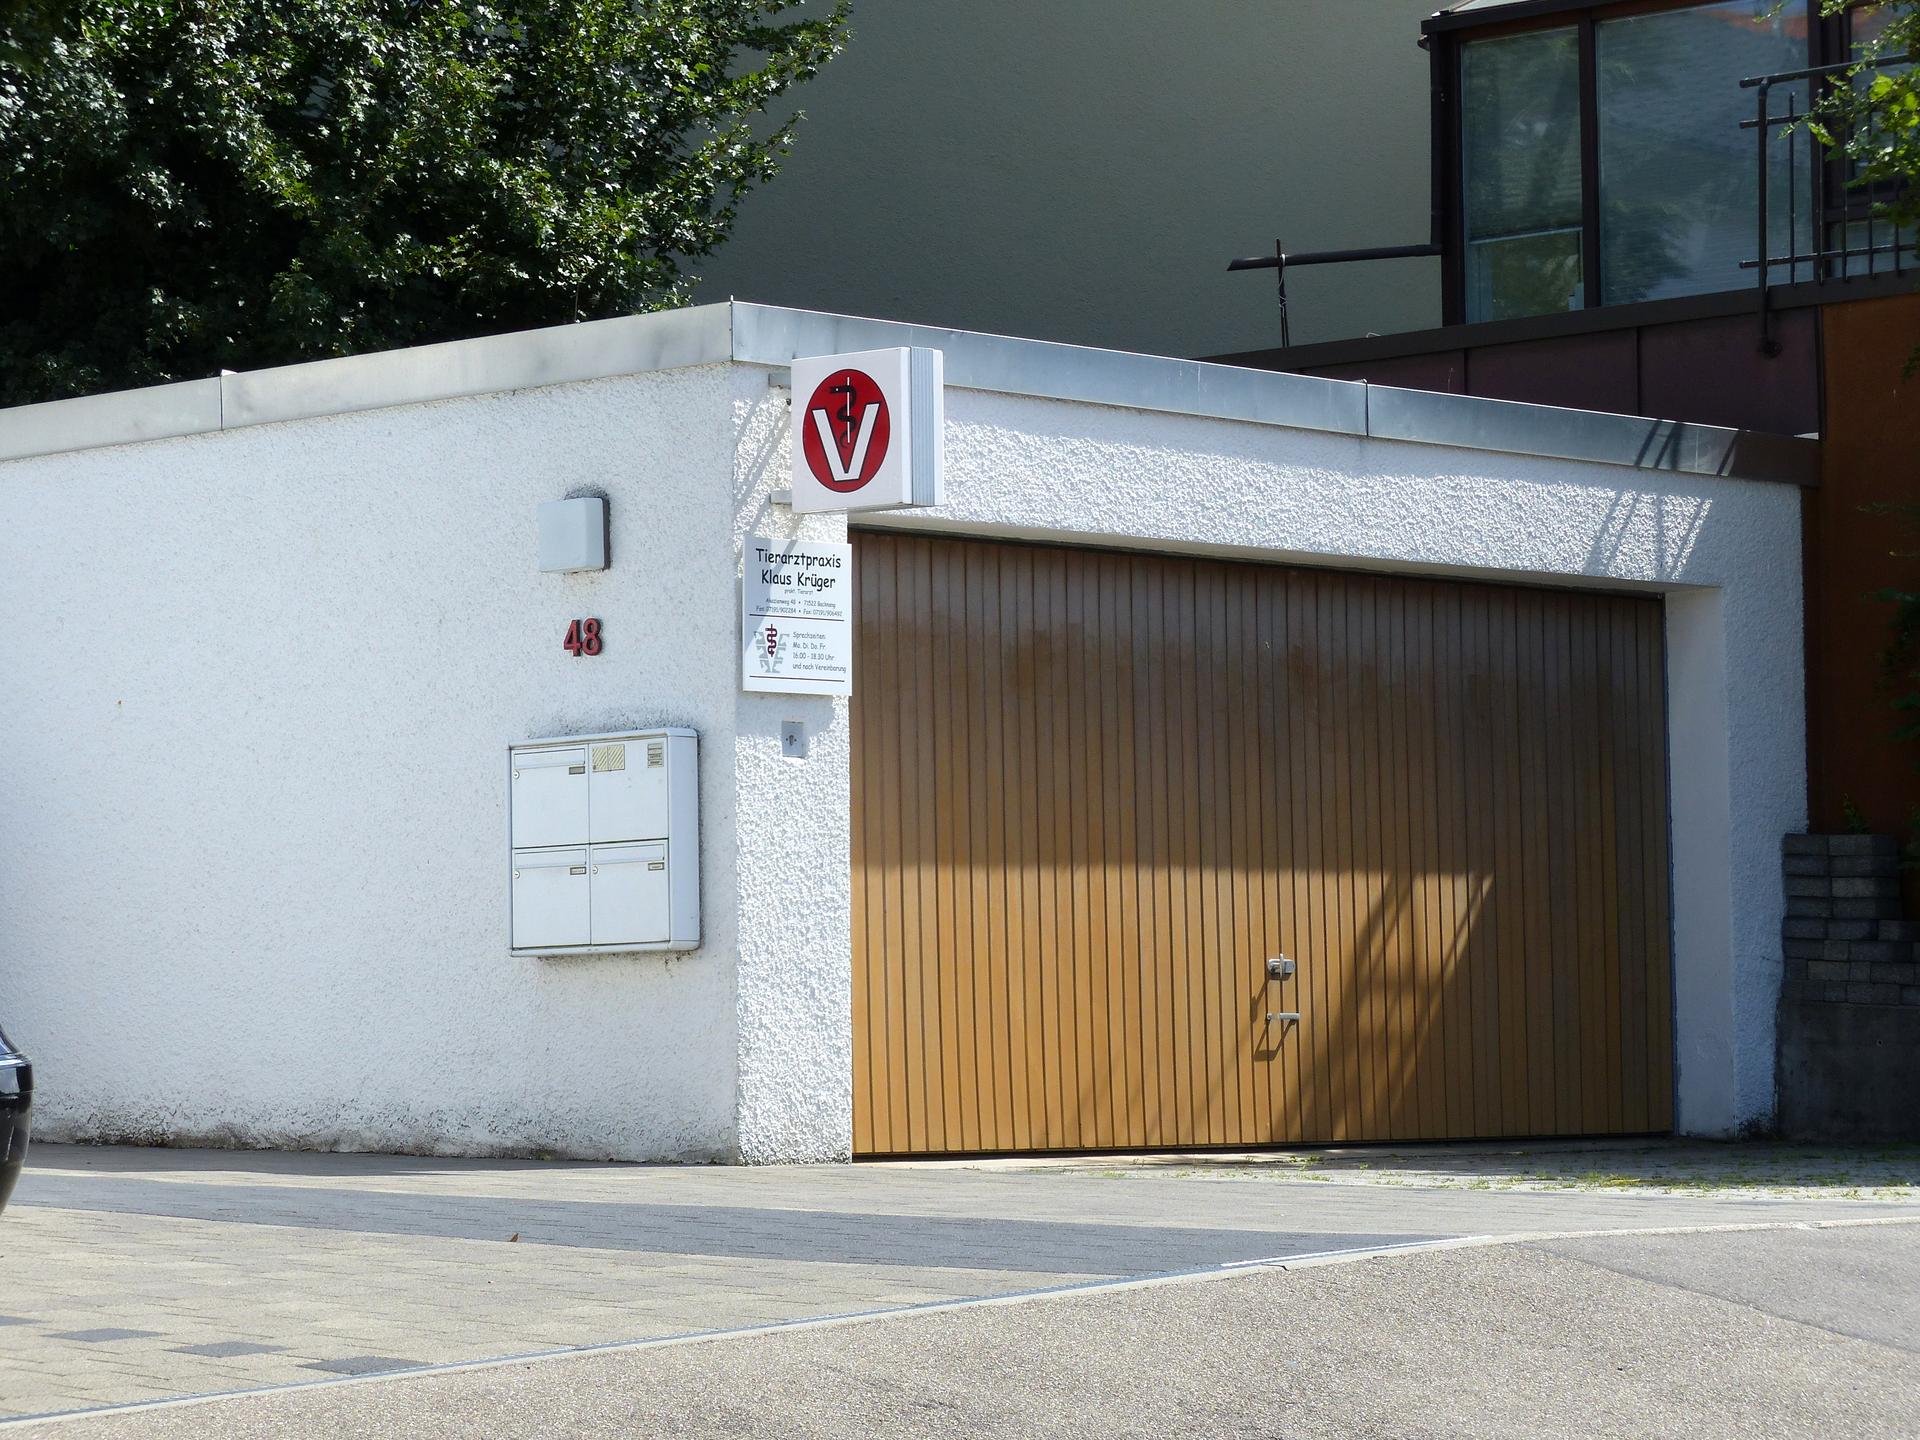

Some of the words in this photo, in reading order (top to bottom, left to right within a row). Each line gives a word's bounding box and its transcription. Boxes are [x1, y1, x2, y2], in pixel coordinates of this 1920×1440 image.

[812, 403, 880, 482] V
[755, 547, 842, 570] Tierarztpraxis
[761, 569, 792, 585] Klaus
[797, 571, 836, 592] Krüger
[563, 617, 603, 657] 48
[815, 663, 847, 674] Vereinbarung
[825, 653, 835, 661] Uhr
